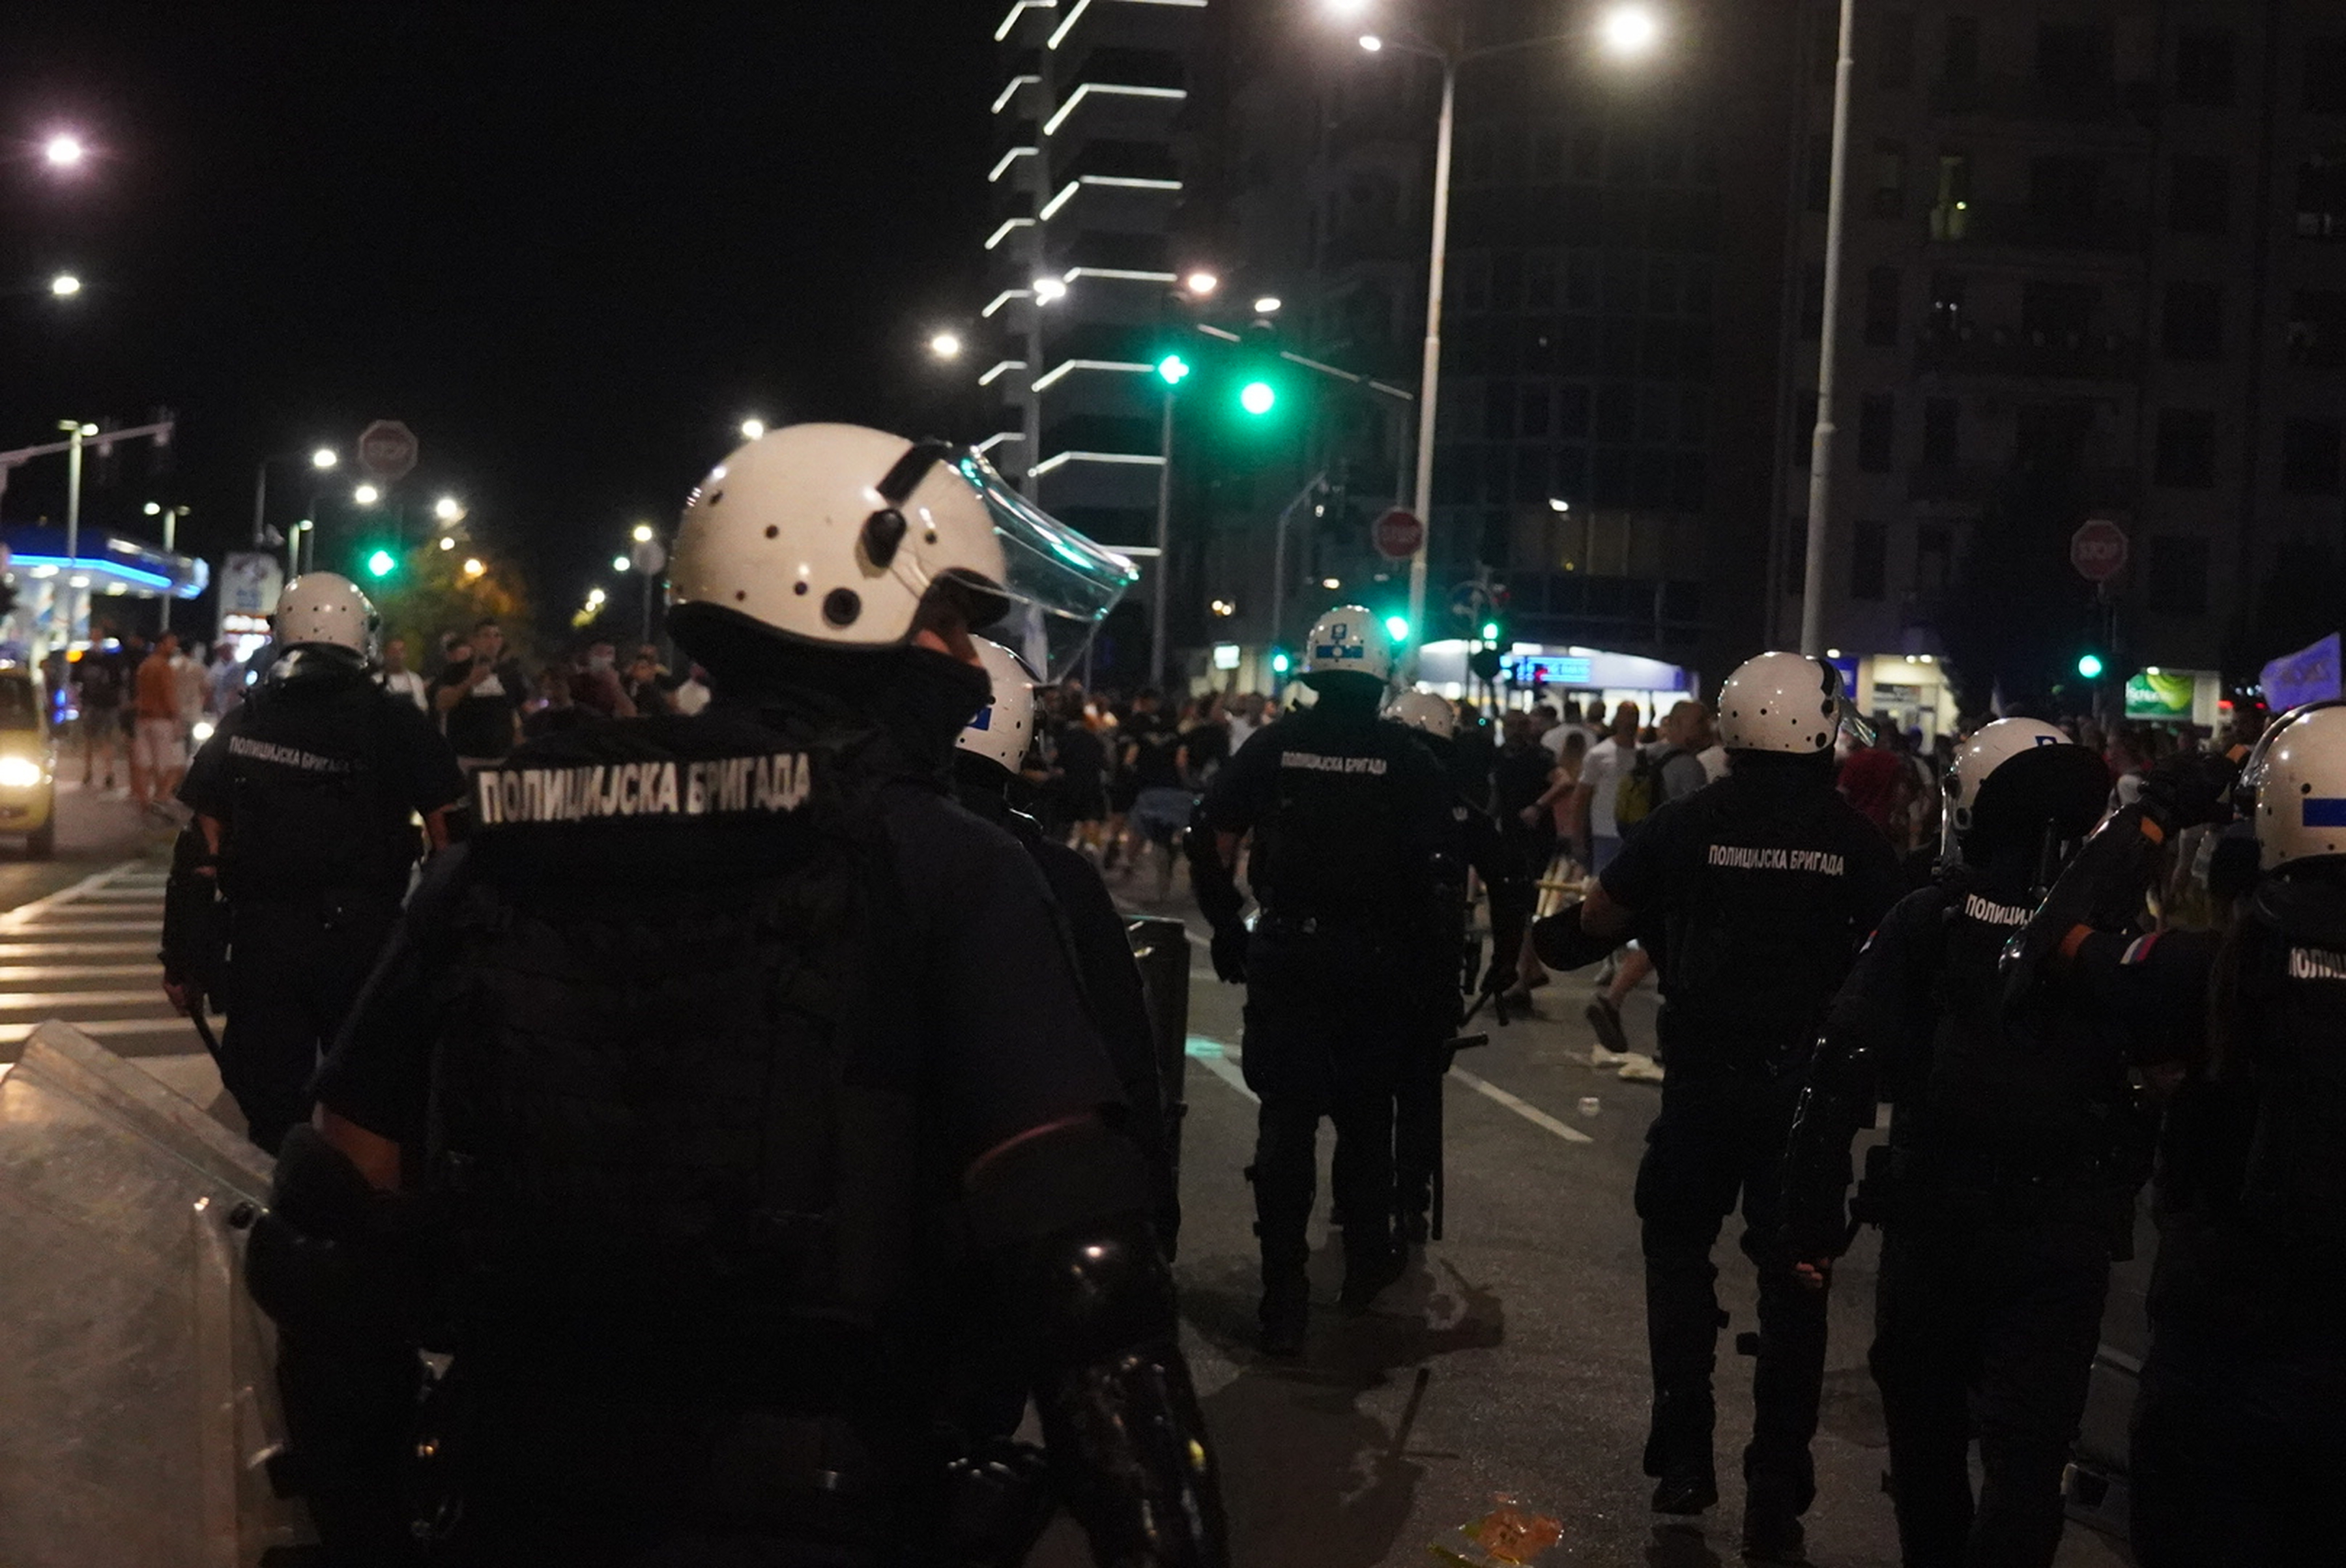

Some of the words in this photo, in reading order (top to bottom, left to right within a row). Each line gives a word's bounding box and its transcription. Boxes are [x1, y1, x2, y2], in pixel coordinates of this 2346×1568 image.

[478, 761, 679, 824] ПОЛИЦИЈСКА
[685, 751, 811, 815] БРИГАДА
[1708, 845, 1787, 869] ПОЛИЦИЈСКА
[1789, 850, 1844, 876] БРИГАДА
